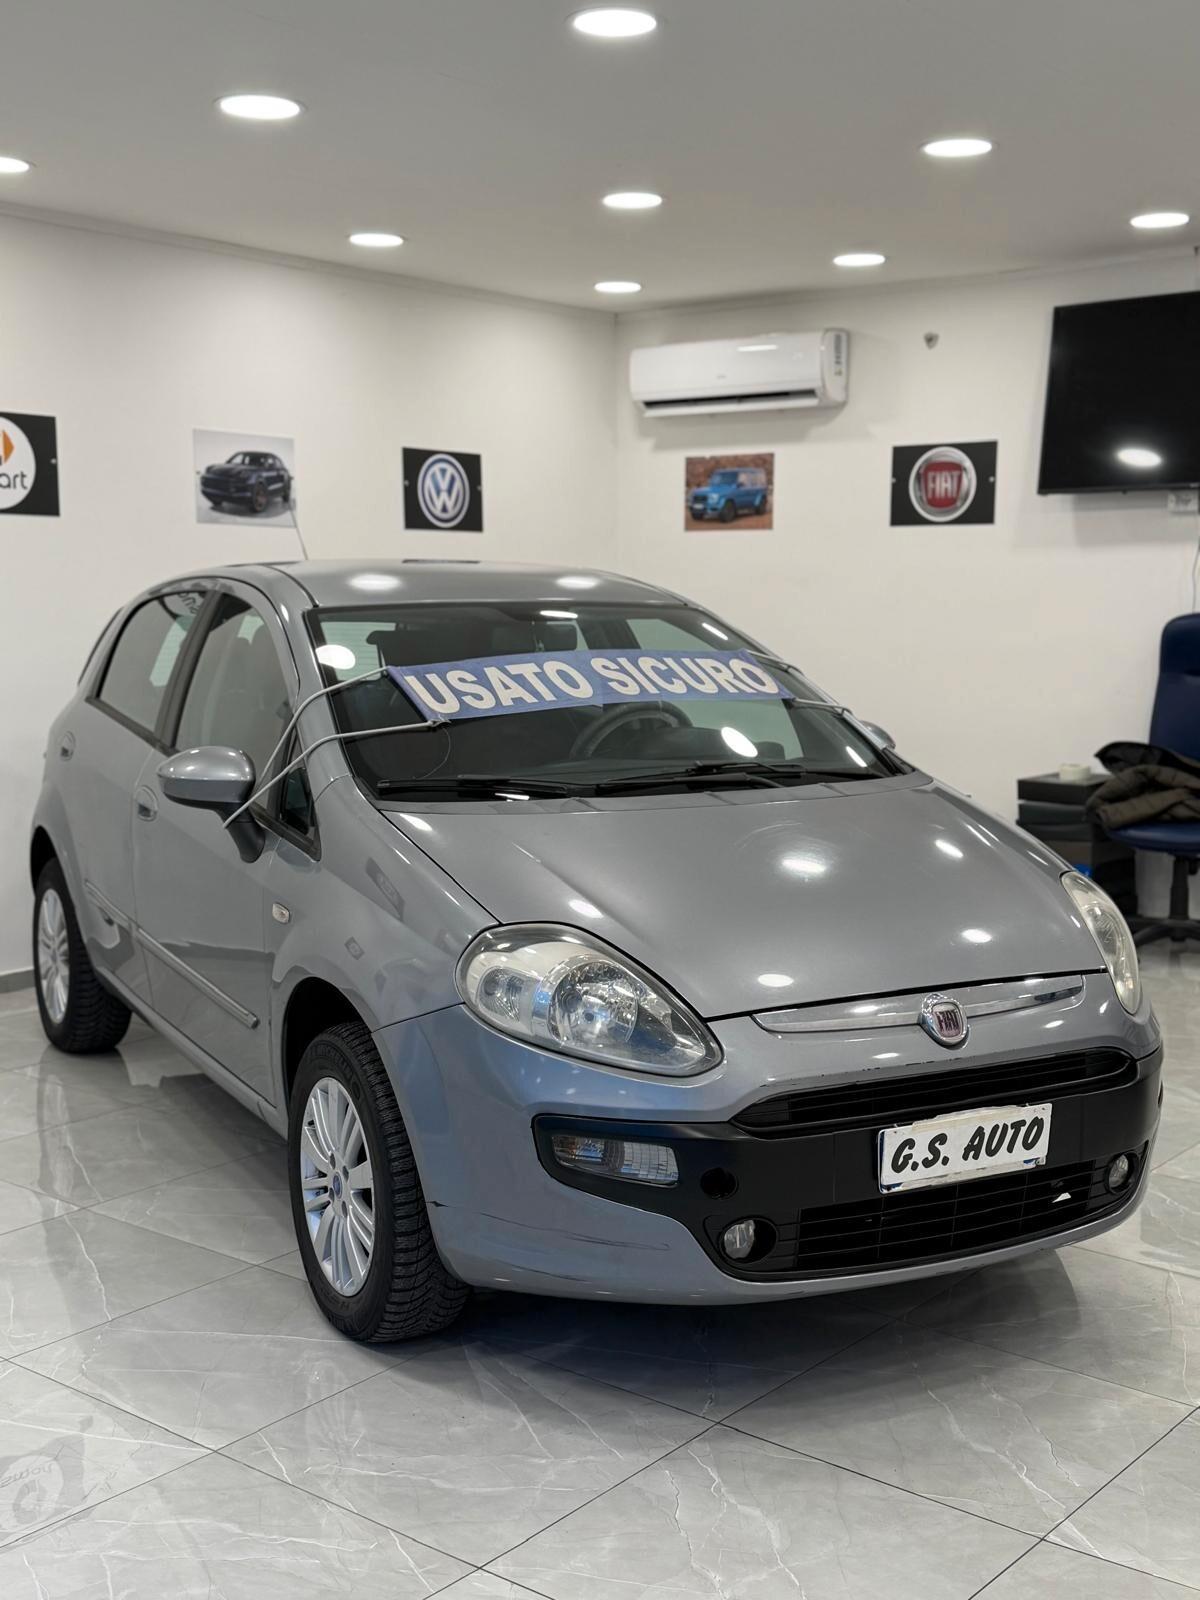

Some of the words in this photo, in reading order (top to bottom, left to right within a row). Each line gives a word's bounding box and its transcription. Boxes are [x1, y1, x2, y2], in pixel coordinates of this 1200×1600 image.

[927, 470, 962, 499] FIAT
[405, 660, 594, 714] USATO
[591, 656, 779, 696] SICURO
[934, 1009, 960, 1033] FIAT
[891, 1132, 950, 1174] G.S.
[962, 1116, 1045, 1161] AUTO
